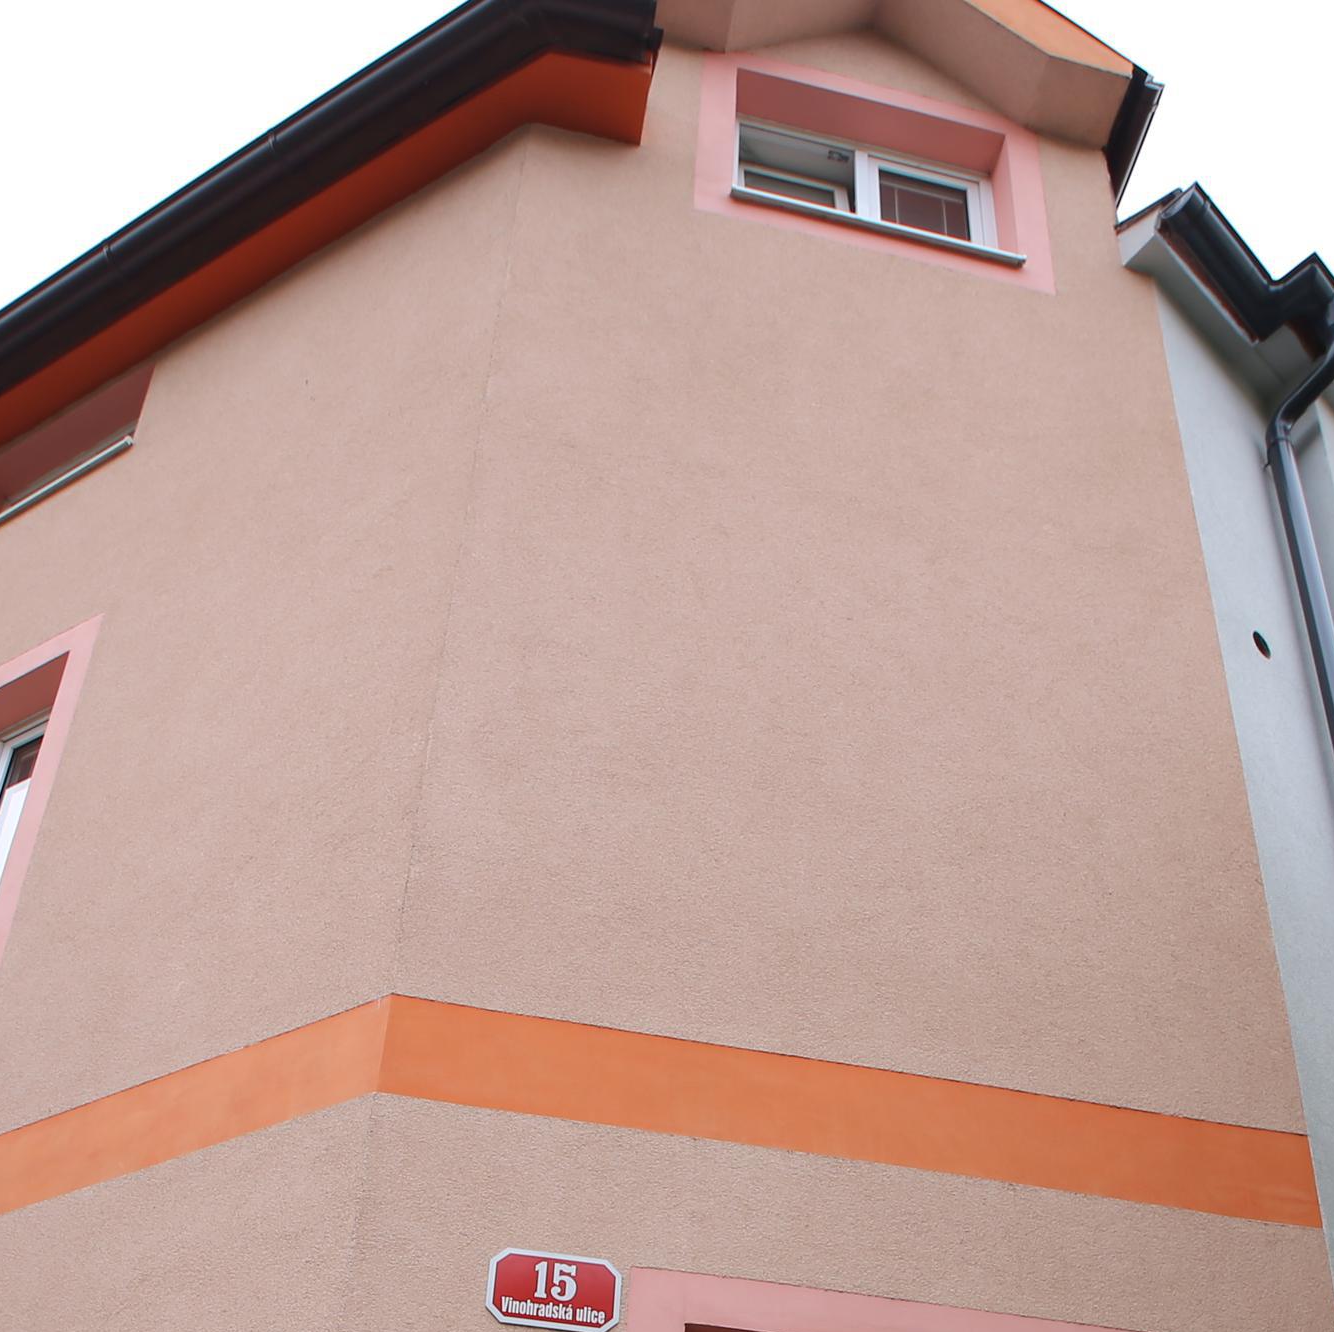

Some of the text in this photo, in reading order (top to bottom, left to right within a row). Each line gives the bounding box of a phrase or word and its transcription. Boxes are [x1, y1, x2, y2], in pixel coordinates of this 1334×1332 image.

[534, 1261, 577, 1301] 15
[501, 1296, 605, 1324] Vinohradská ulice
